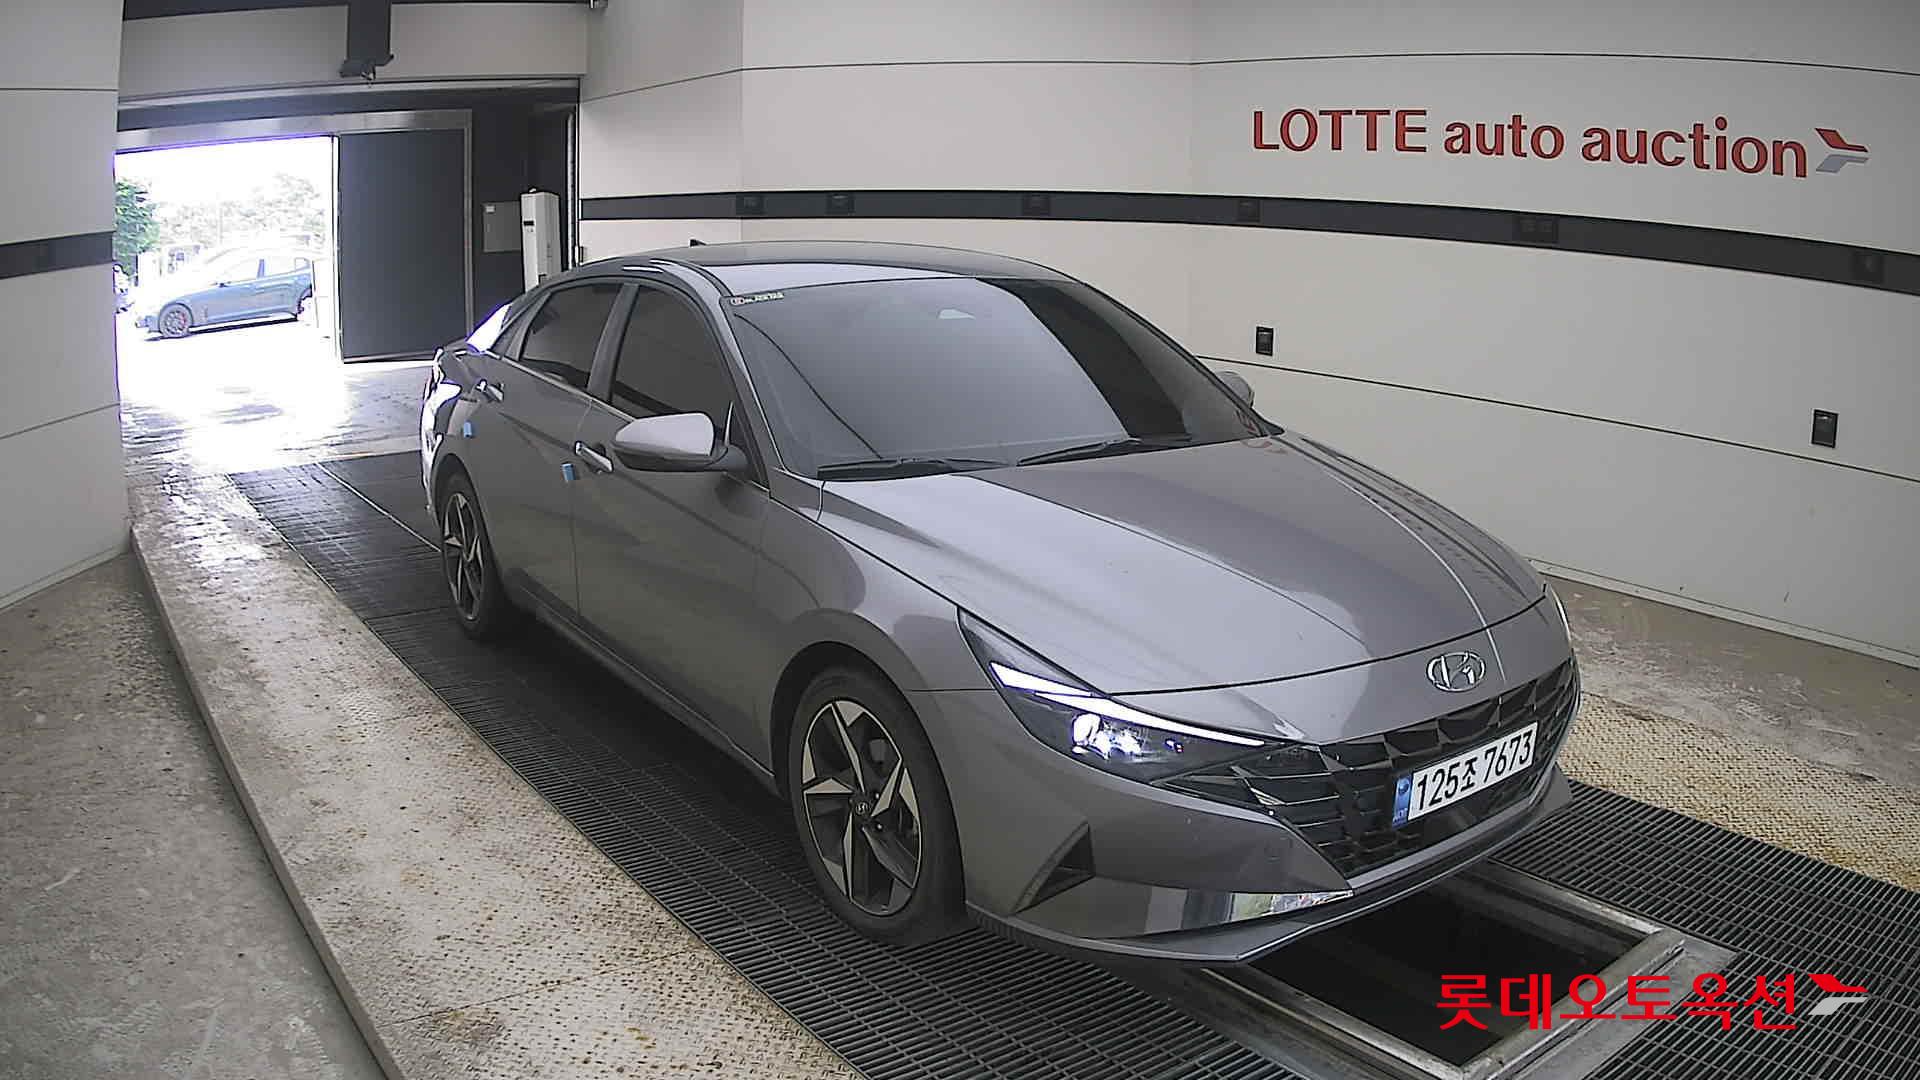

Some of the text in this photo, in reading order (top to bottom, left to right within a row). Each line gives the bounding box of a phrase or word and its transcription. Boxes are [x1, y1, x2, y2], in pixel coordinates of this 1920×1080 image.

[1252, 109, 1808, 179] LOTTE auto auction
[1416, 729, 1533, 811] 125조 7673
